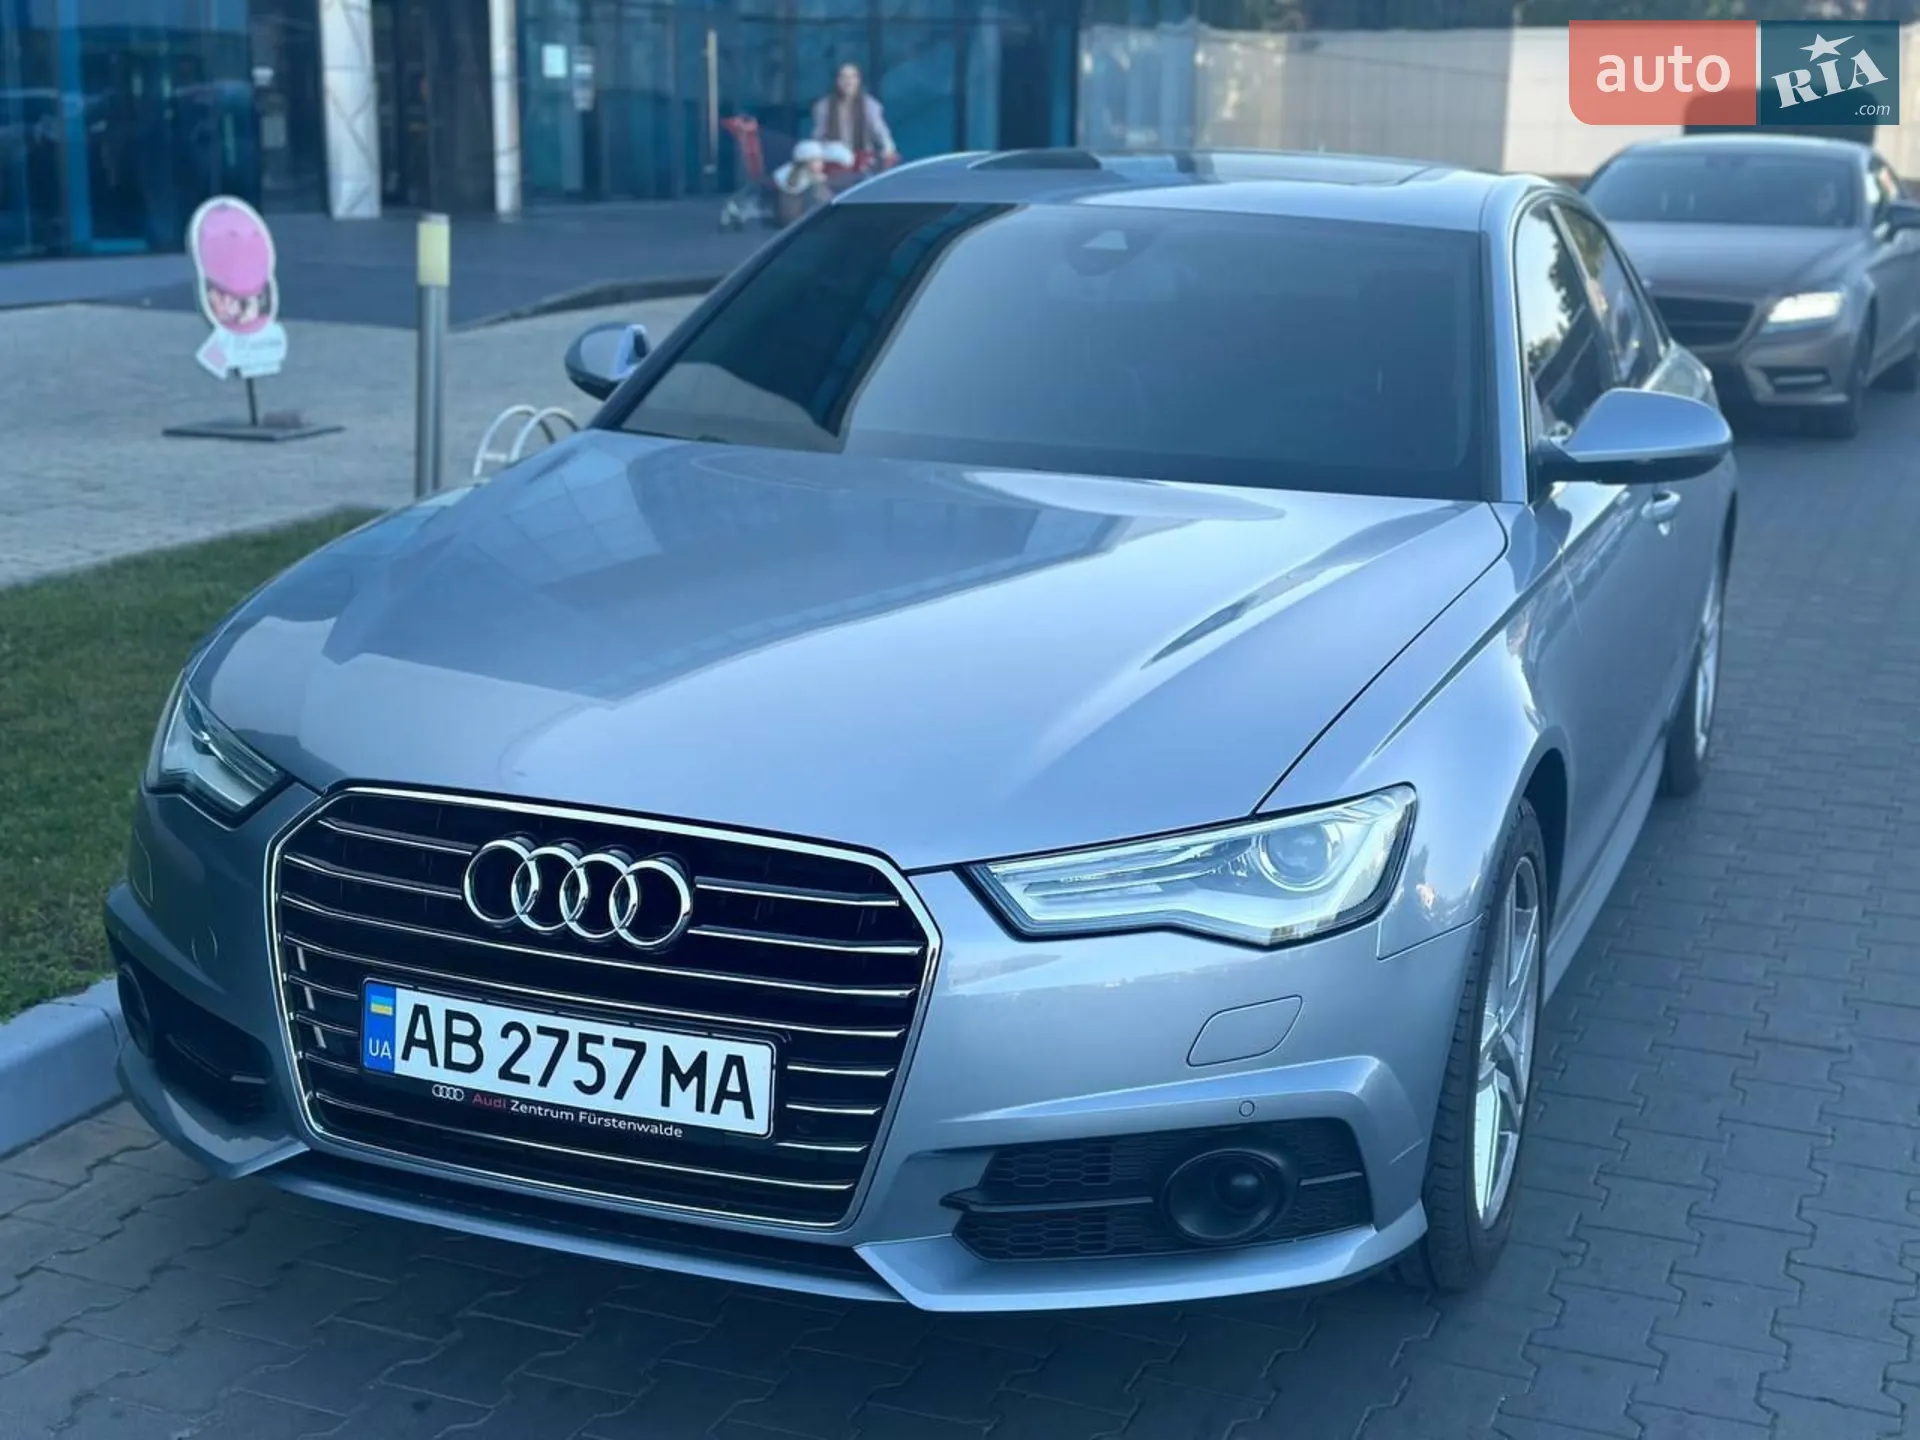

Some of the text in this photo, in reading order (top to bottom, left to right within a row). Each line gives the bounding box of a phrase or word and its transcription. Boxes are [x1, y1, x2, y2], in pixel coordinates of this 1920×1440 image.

[368, 1038, 392, 1061] UA
[401, 1004, 755, 1120] AB 2757 MA
[472, 1092, 684, 1138] Audi Zentrum Fürstenwalde
